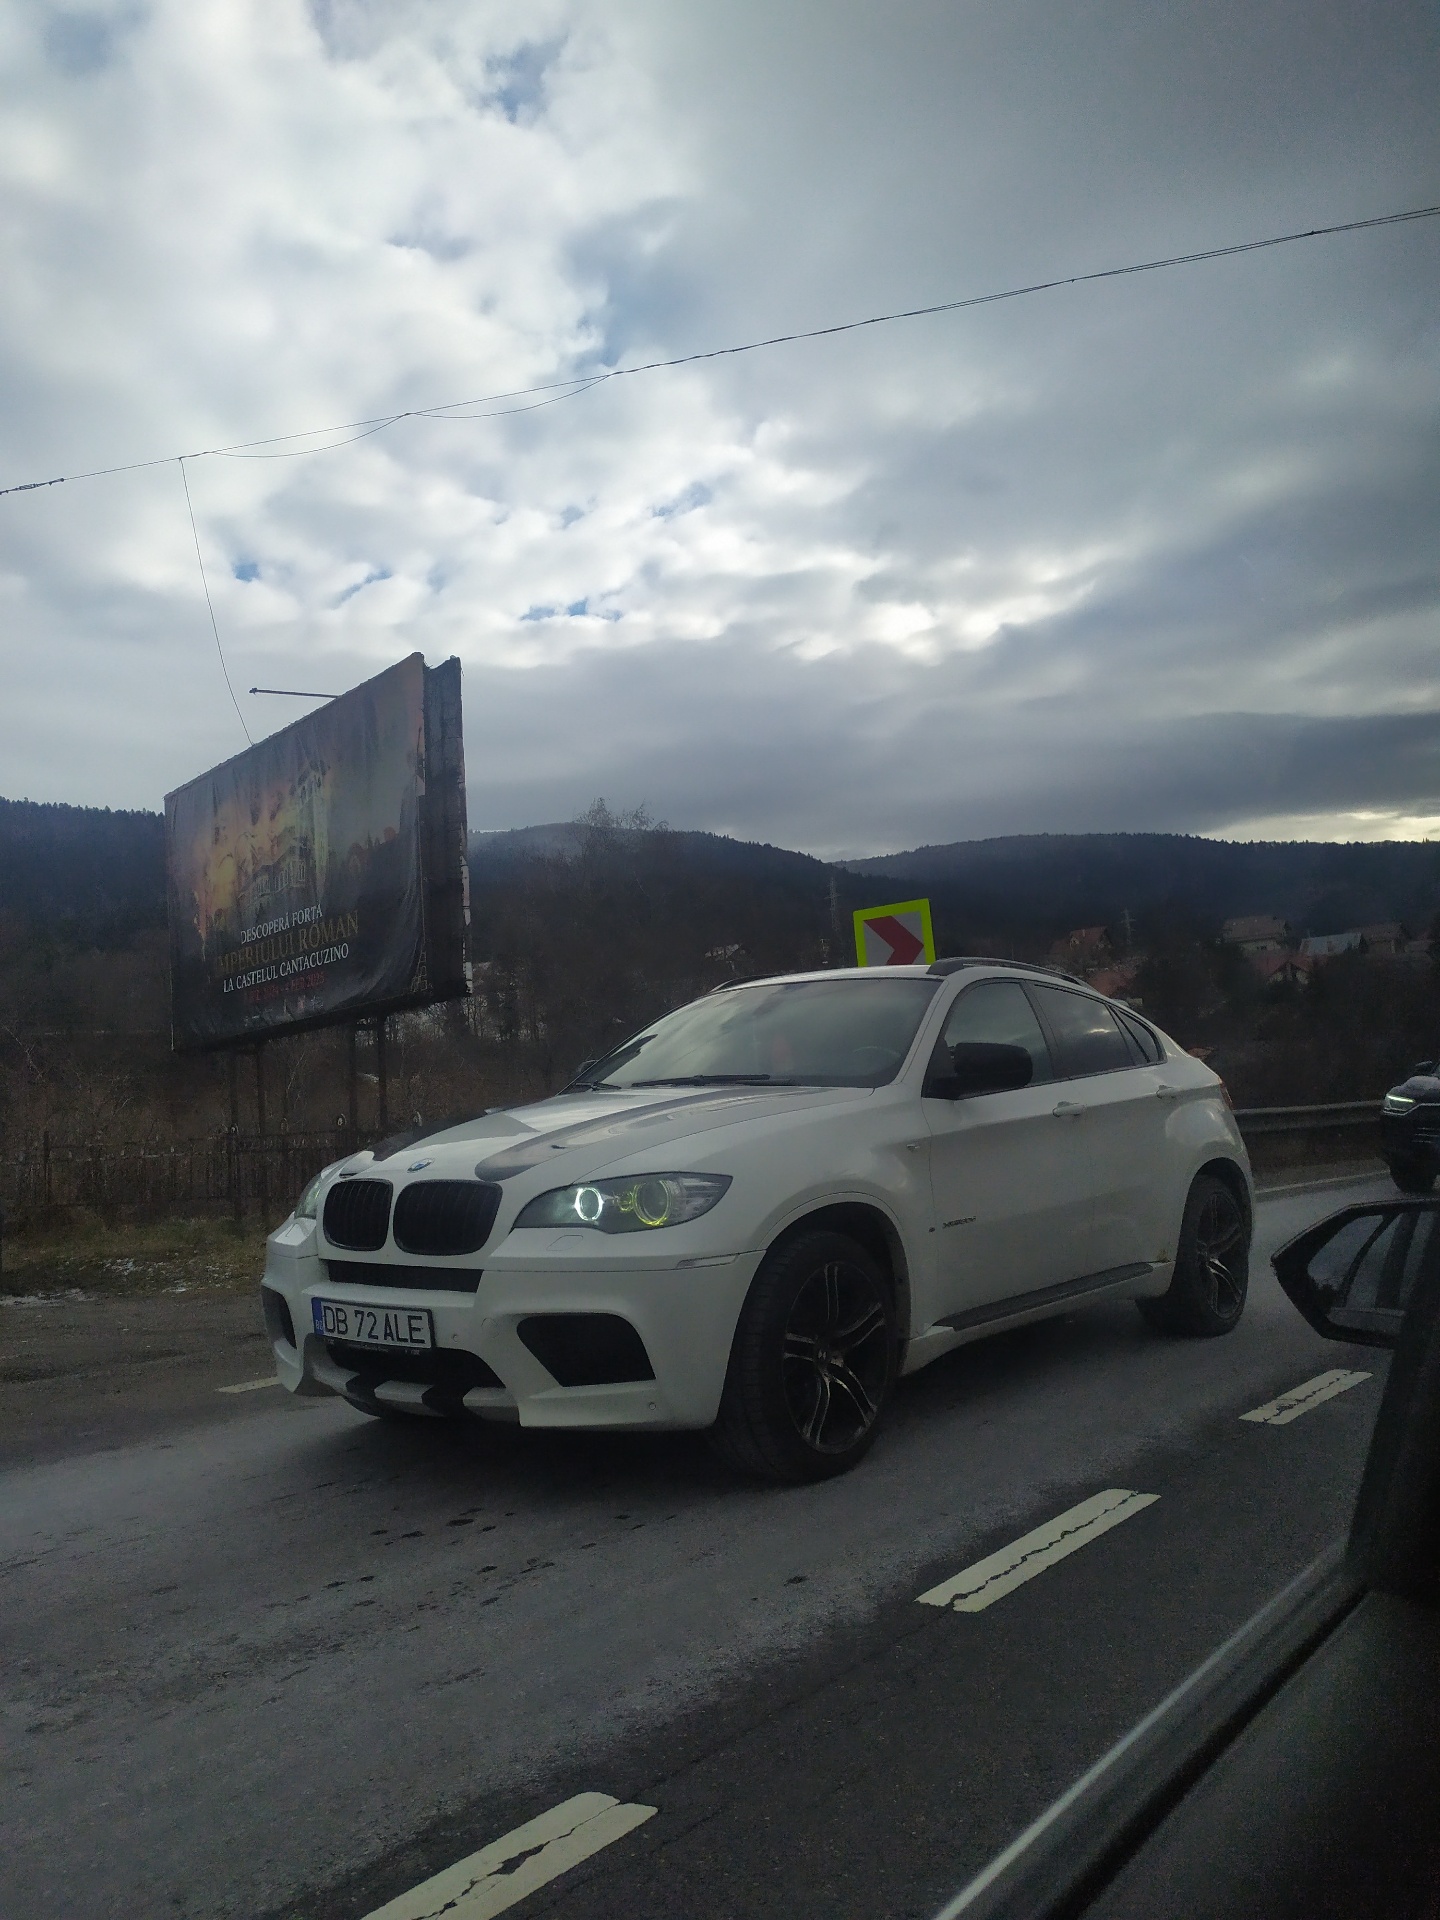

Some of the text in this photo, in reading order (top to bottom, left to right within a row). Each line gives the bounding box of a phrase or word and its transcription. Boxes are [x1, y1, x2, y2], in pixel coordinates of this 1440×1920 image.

[298, 910, 359, 952] ROMAN
[223, 943, 349, 993] LA CASTELUL CANTACUZINO
[323, 1305, 349, 1335] DB
[354, 1309, 379, 1340] 72
[384, 1313, 426, 1344] ALE
